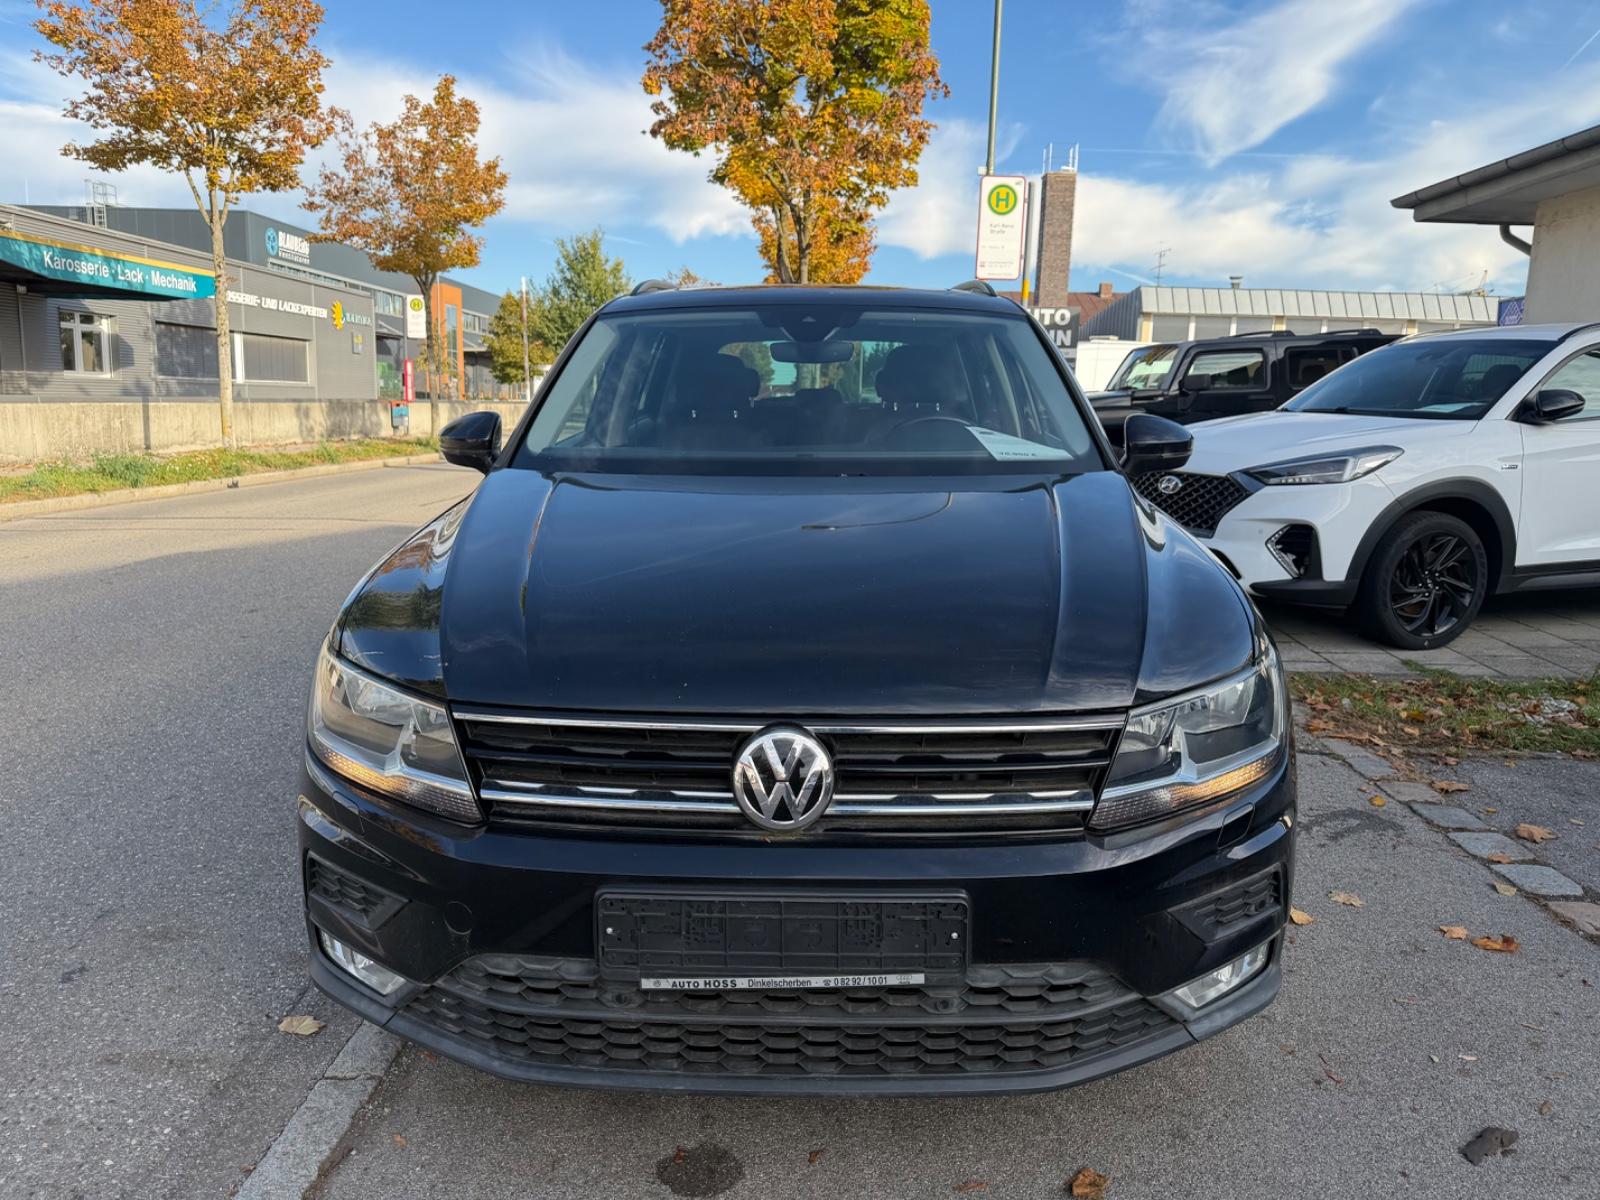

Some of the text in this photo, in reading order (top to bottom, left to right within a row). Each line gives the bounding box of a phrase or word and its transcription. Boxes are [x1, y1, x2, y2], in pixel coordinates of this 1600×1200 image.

[996, 191, 1010, 208] H
[43, 250, 197, 292] Karosserie Lack Mechanik
[671, 980, 700, 988] AUTO
[703, 979, 738, 988] HOSS
[747, 978, 812, 988] Dinkelscherben
